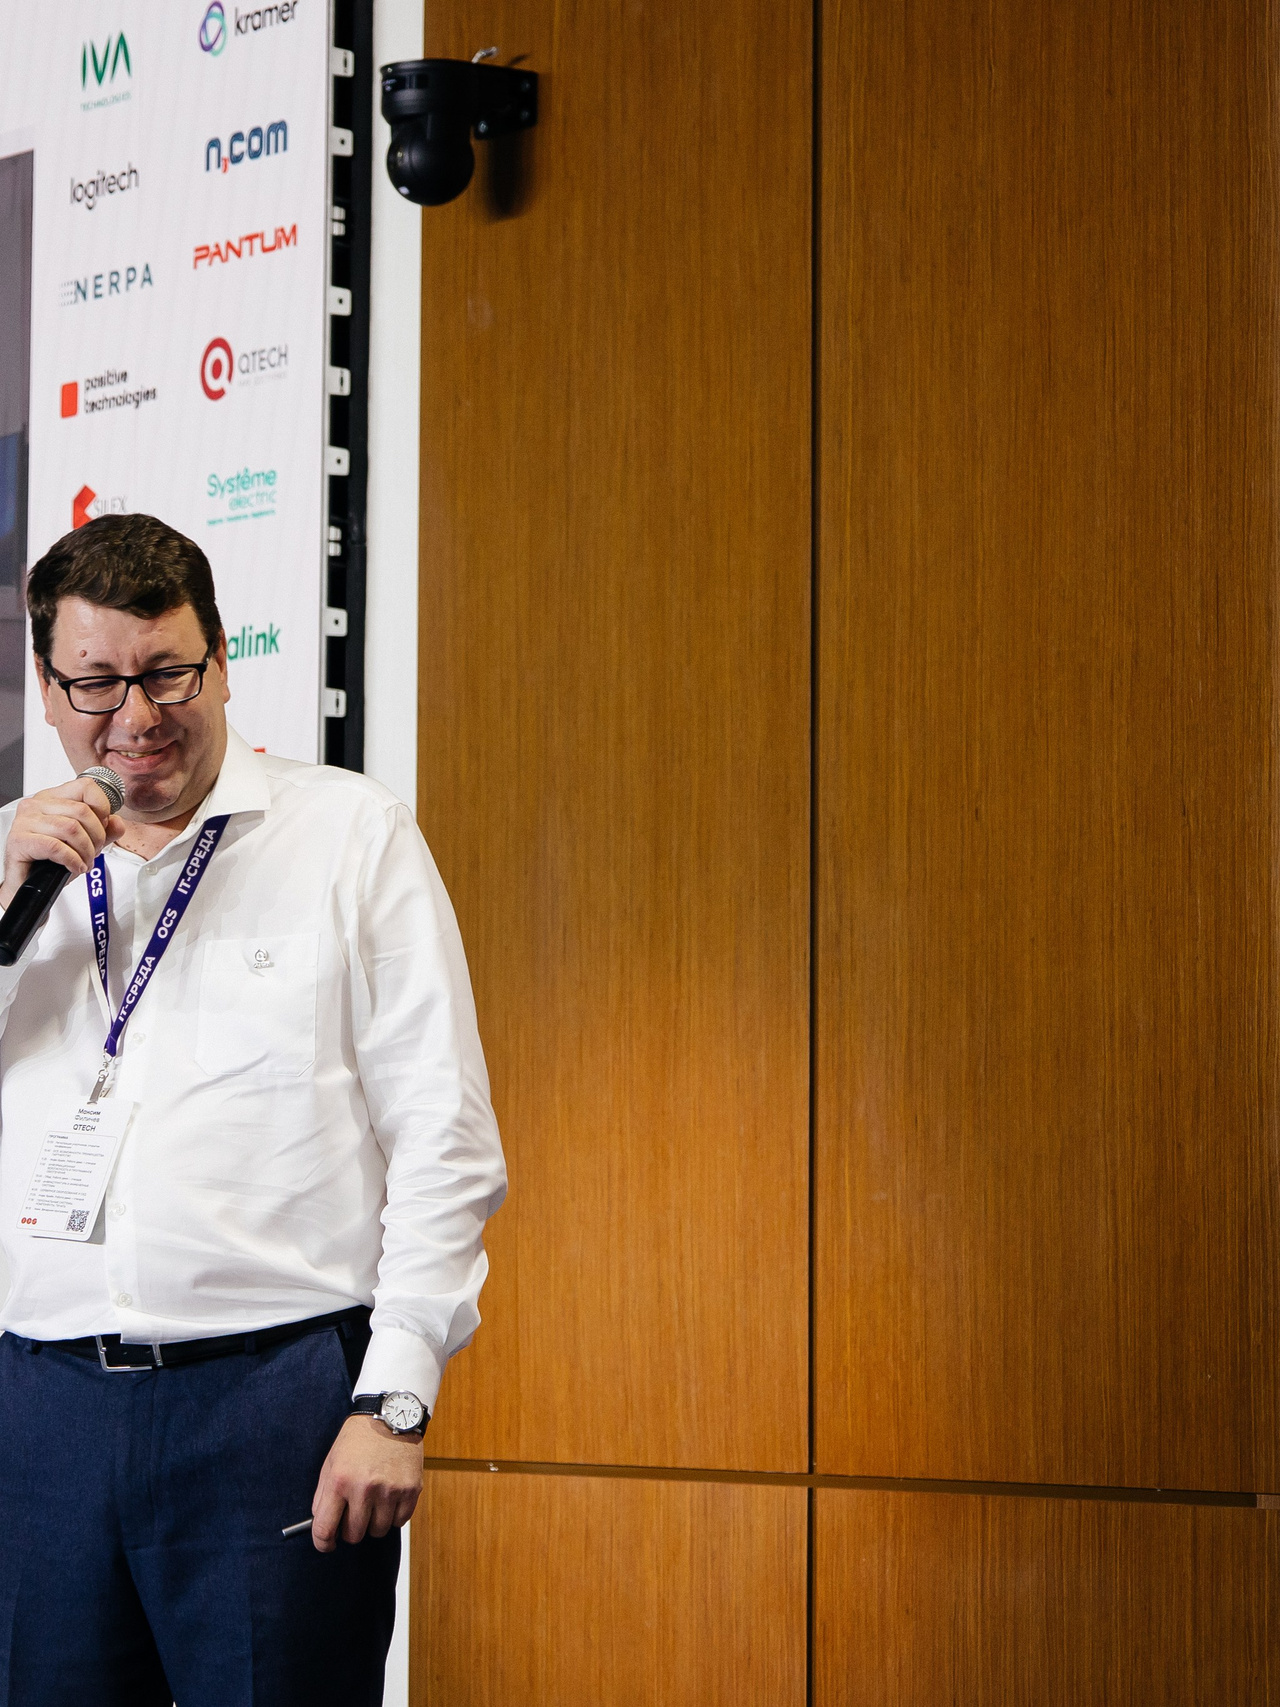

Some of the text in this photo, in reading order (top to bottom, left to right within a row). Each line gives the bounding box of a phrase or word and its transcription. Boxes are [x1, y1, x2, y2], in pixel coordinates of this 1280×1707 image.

[234, 0, 299, 36] kramer
[70, 162, 139, 210] logitech
[193, 223, 297, 270] PANTUM
[238, 344, 288, 375] QTECH
[84, 368, 128, 393] positive
[84, 385, 158, 414] technologies
[227, 622, 281, 661] alink
[89, 867, 103, 898] OCS
[157, 908, 178, 939] OCS
[72, 1123, 96, 1132] QTECH
